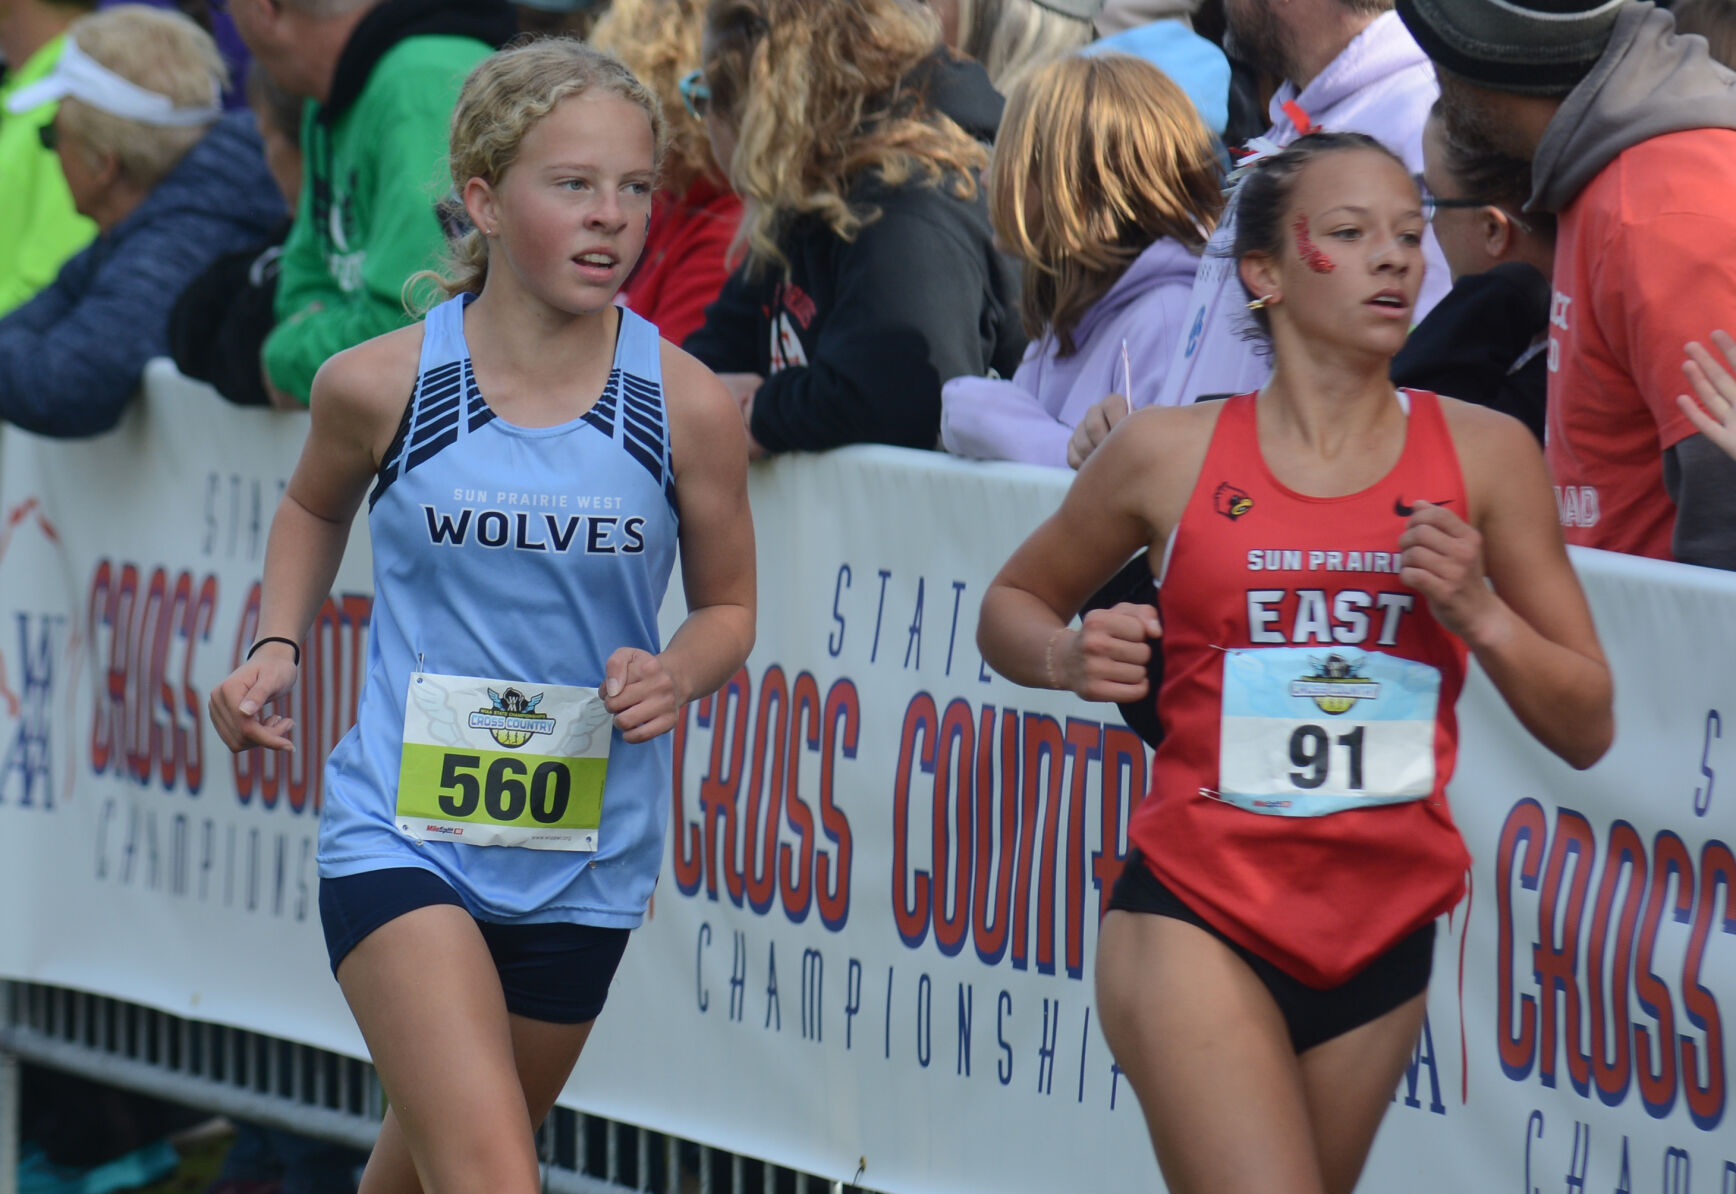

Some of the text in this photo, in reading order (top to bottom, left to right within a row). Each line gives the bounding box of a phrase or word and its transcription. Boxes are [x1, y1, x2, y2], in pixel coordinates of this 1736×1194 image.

[419, 504, 648, 555] WOLVES
[453, 488, 623, 510] SUN PRAIRIE WEST
[1247, 549, 1403, 574] SUN PRAIRI
[828, 563, 992, 682] STAT
[1246, 588, 1415, 647] EAST
[471, 714, 553, 732] CROSS COUNTRY
[438, 753, 571, 823] 560
[1288, 724, 1366, 790] 91
[672, 662, 1148, 979] CROSS COUNTR
[1497, 797, 1736, 1131] CROSS
